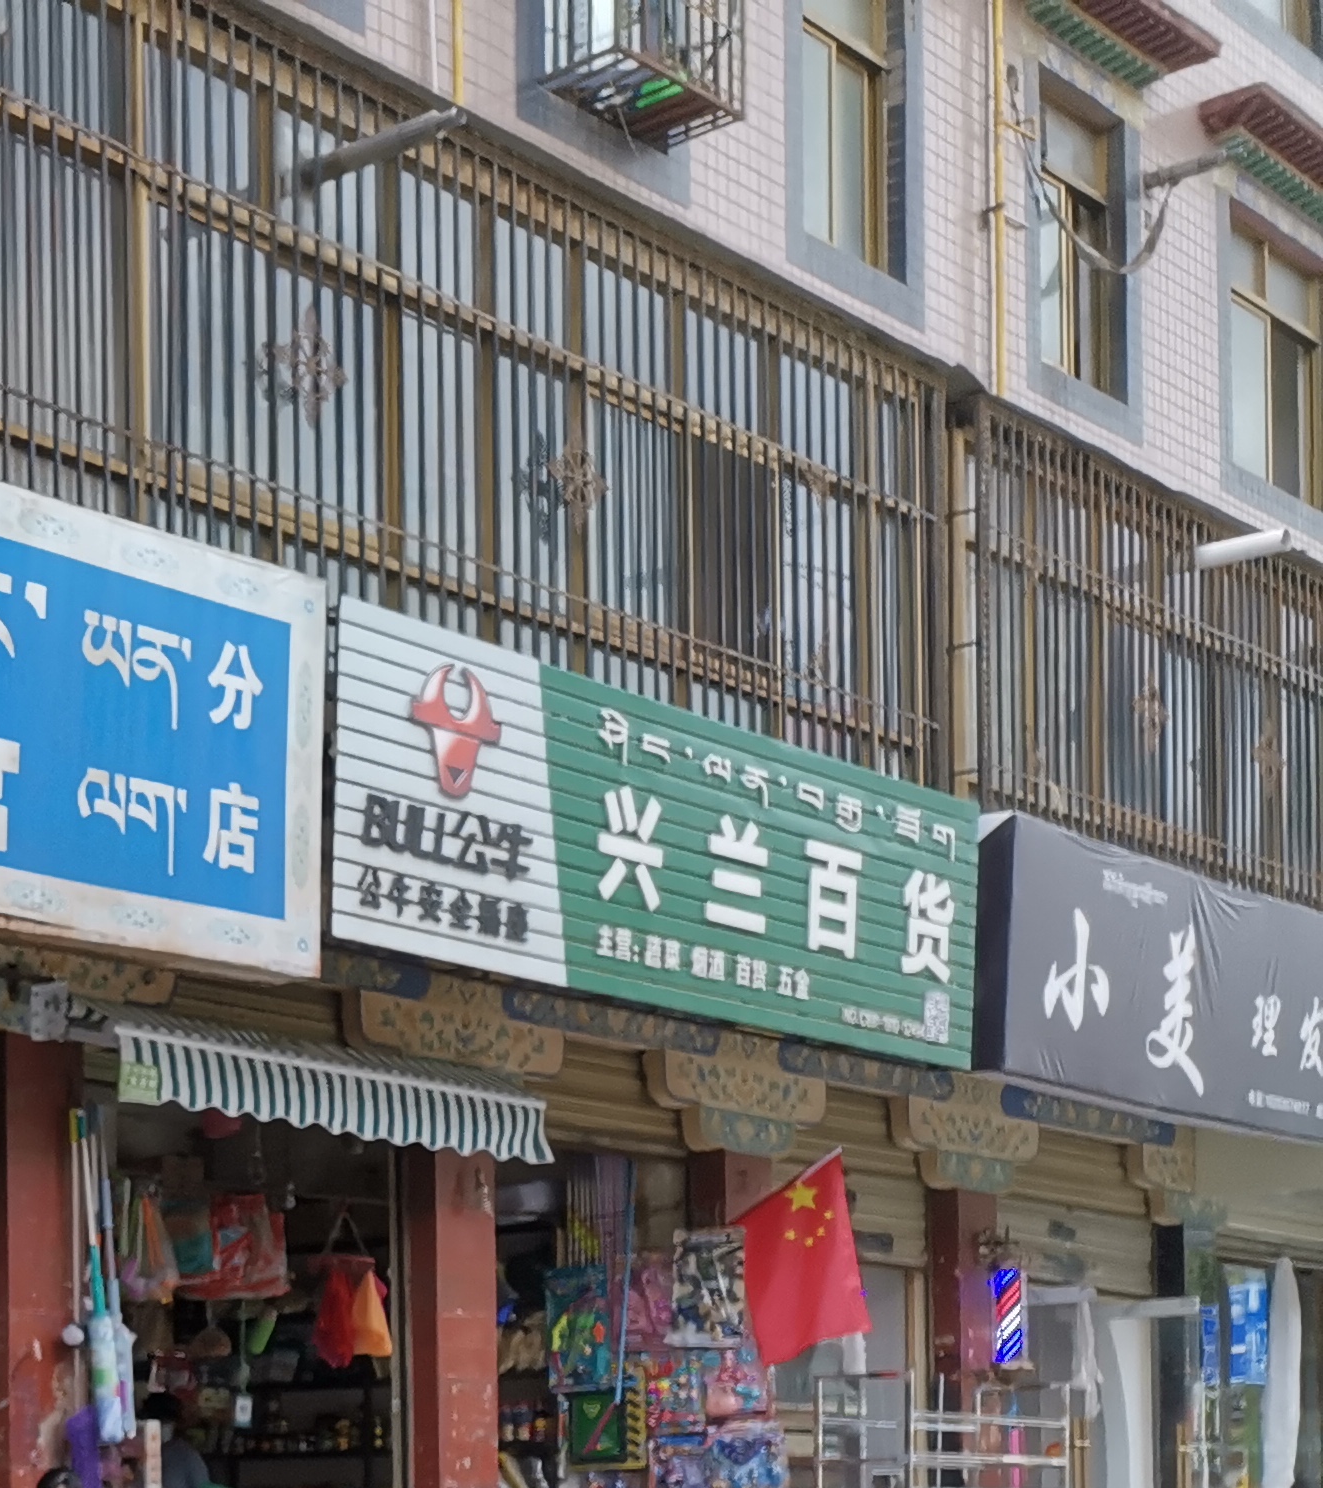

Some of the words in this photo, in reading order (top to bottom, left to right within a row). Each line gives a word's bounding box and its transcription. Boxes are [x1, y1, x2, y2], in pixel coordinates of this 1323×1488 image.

[203, 640, 264, 874] 分店
[596, 785, 956, 984] 兴兰百货
[1043, 907, 1204, 1098] 小美
